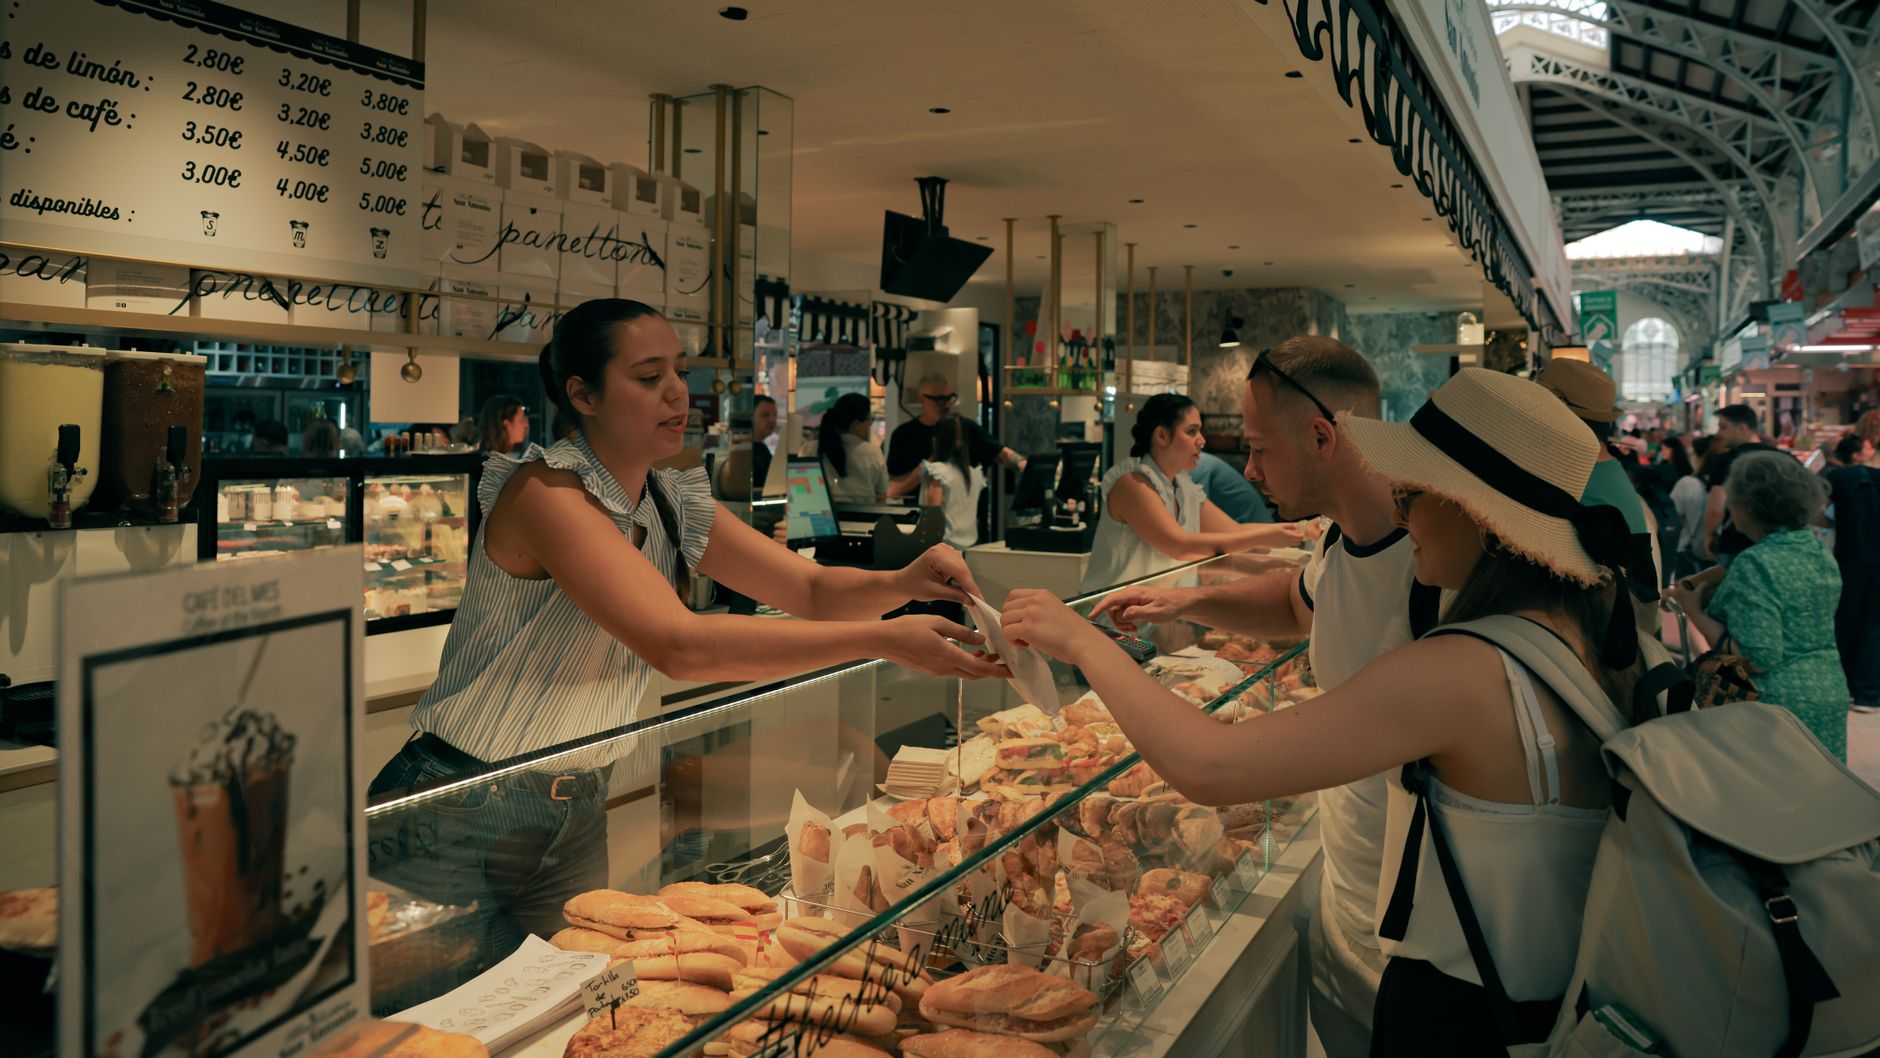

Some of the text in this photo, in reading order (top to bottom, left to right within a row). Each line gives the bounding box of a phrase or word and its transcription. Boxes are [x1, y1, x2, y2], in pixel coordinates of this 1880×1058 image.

[23, 42, 60, 70] de
[66, 51, 140, 88] limón
[182, 44, 244, 75] 2,80€
[182, 81, 243, 111] 2,80€
[278, 68, 332, 97] 3,20€
[22, 86, 60, 114] de
[66, 99, 122, 133] café
[361, 89, 409, 116] 3,80€
[277, 103, 331, 131] 3,20€
[181, 121, 243, 149] 3,50€
[360, 122, 408, 148] 3,80€
[276, 141, 330, 167] 4,50€
[181, 161, 242, 188] 3,00€
[10, 188, 120, 221] disponibles
[276, 178, 330, 203] 4,00€
